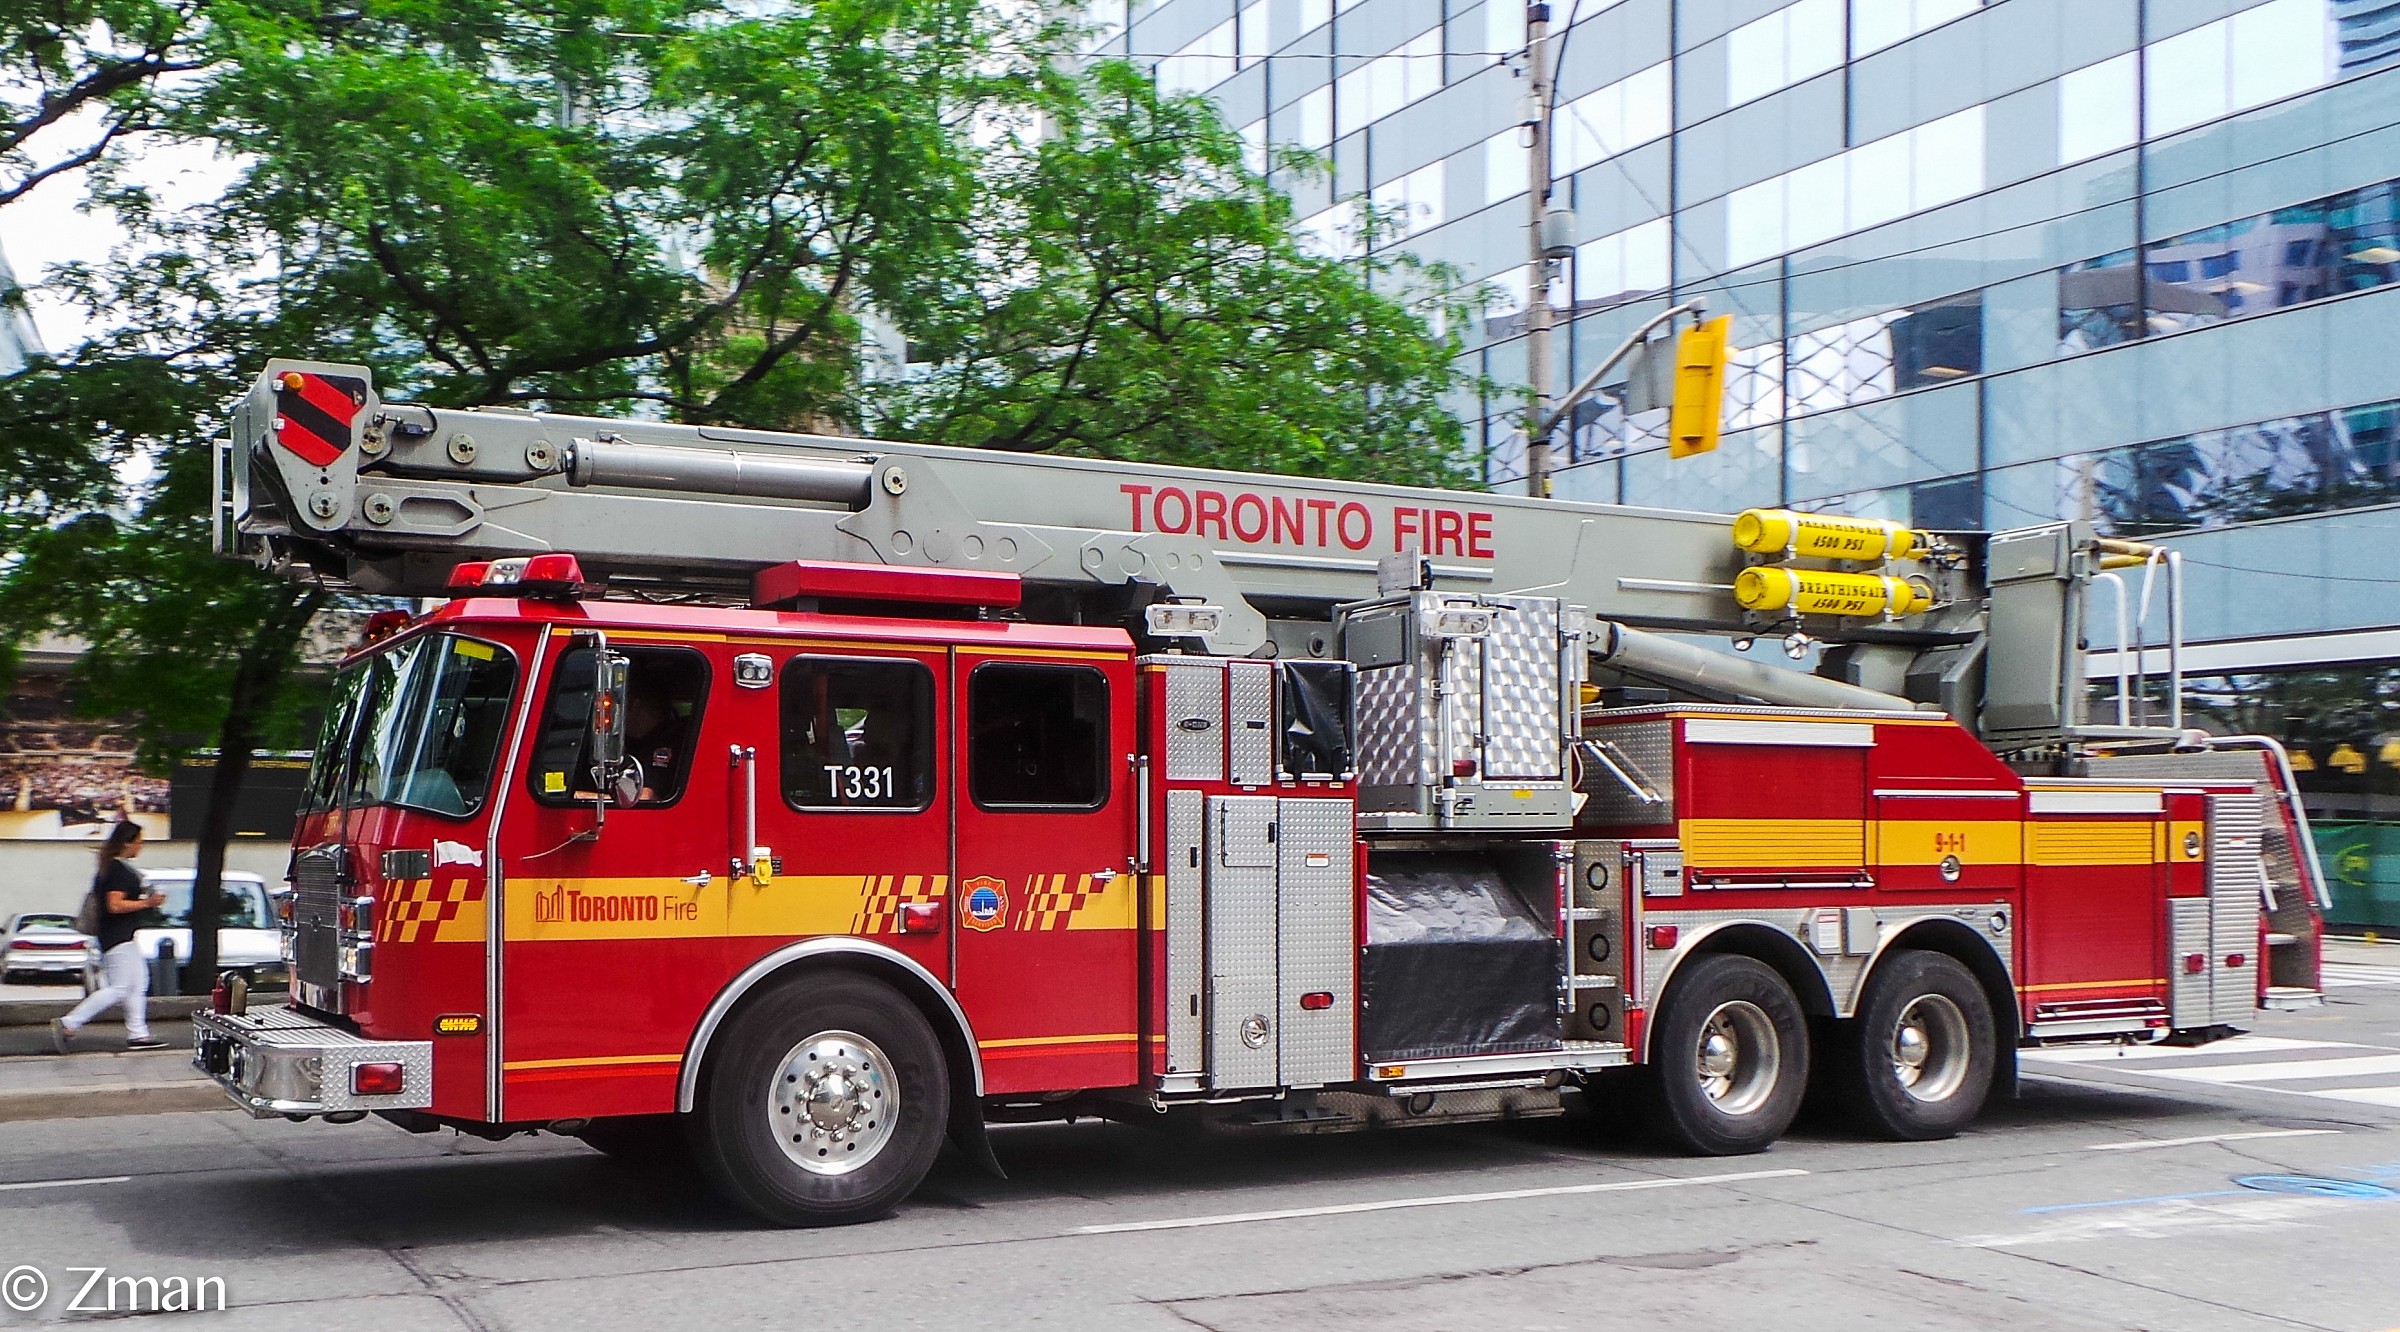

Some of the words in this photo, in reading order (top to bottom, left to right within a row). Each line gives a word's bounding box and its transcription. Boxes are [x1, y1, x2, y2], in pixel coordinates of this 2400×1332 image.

[1120, 484, 1372, 551] TORONTO
[1394, 506, 1495, 558] FIRE
[1813, 536, 1840, 549] 4500
[1843, 538, 1865, 551] PSI
[1812, 599, 1840, 609] 4500
[1842, 600, 1866, 611] PSI
[824, 765, 893, 798] T331
[1936, 832, 1965, 852] 9-1-1
[567, 890, 658, 922] TORONTO
[664, 896, 698, 921] Fire
